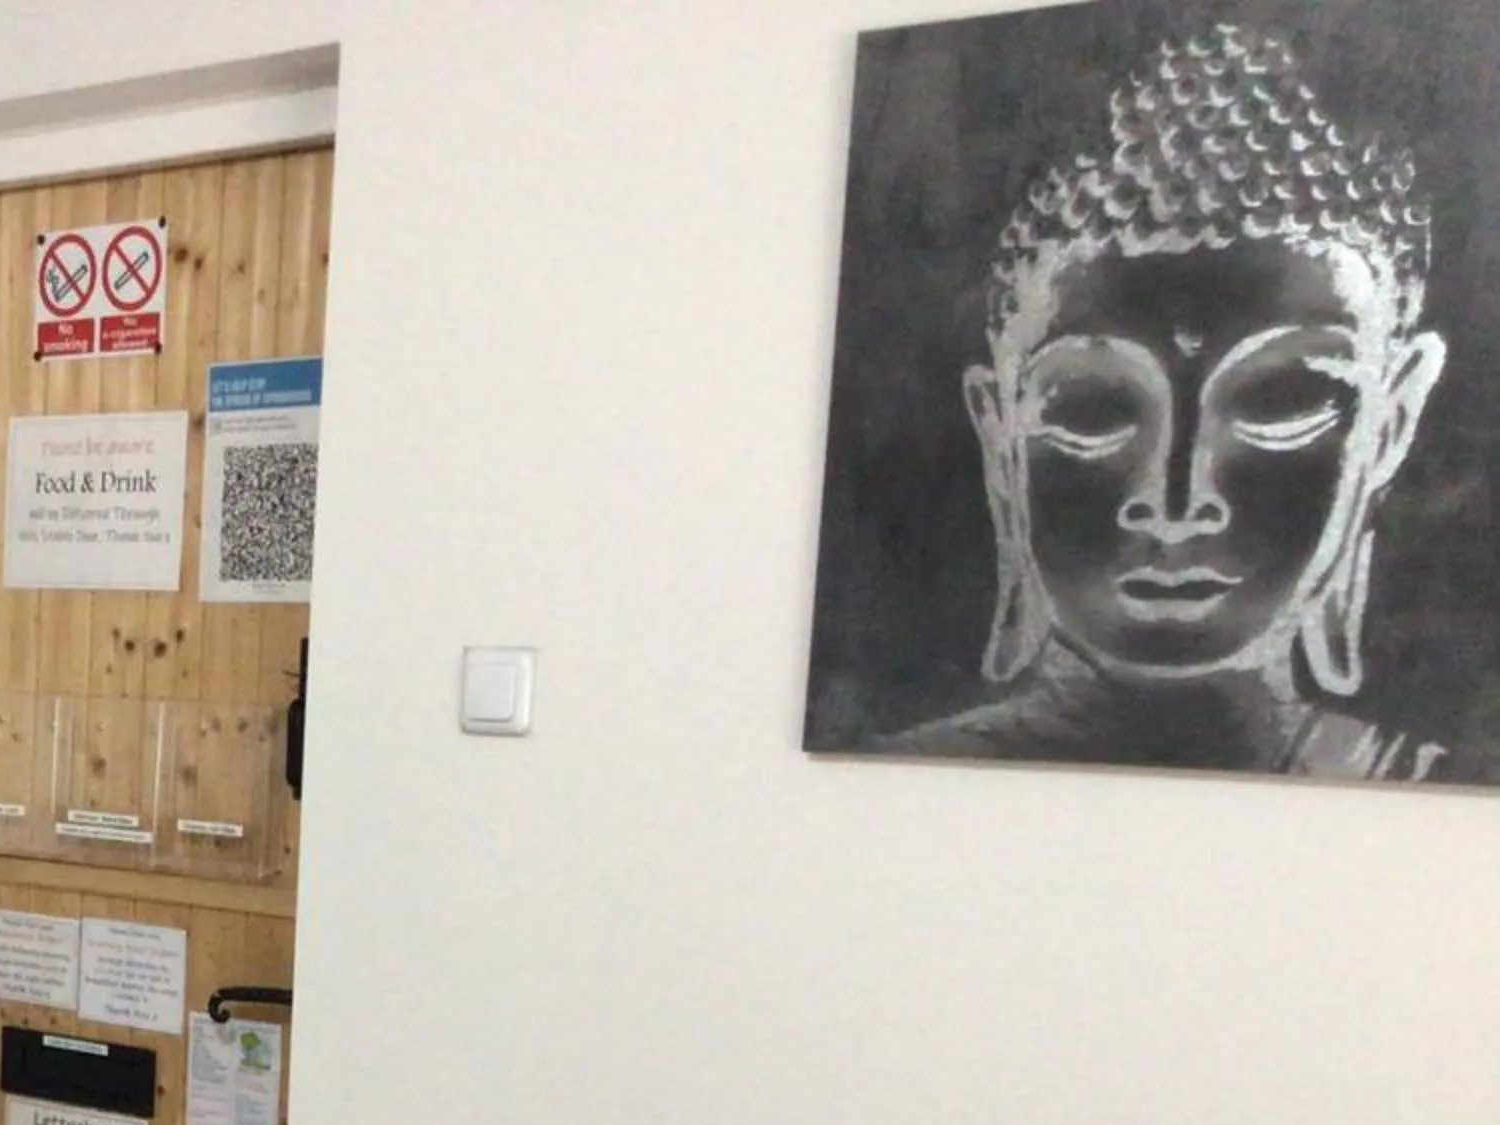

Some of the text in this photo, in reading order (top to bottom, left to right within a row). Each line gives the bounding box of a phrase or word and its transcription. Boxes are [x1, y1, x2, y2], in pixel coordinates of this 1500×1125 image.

[35, 468, 157, 495] Food & Drink
